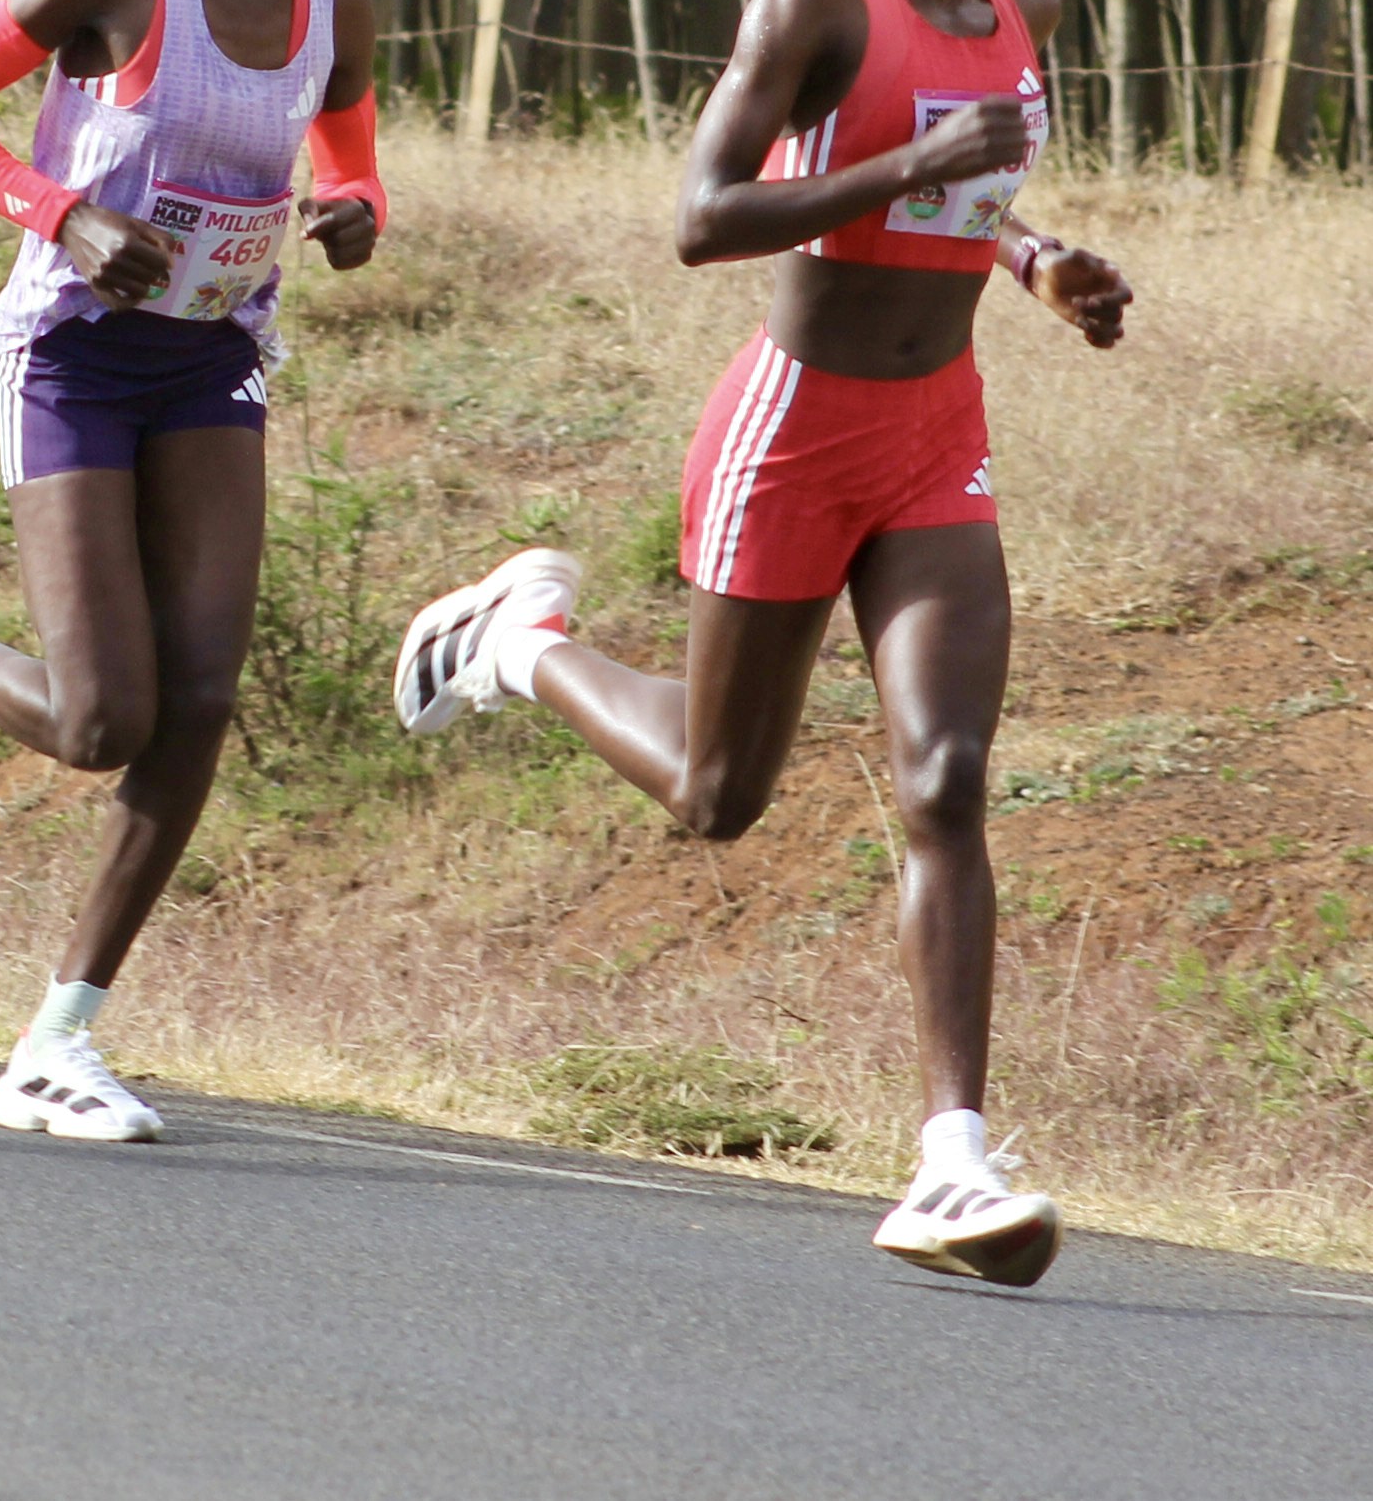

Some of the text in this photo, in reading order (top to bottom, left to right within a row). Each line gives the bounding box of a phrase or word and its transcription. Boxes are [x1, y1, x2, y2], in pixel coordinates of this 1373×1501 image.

[153, 205, 201, 226] HALF
[205, 207, 290, 233] MILICENT
[208, 235, 271, 267] 469
